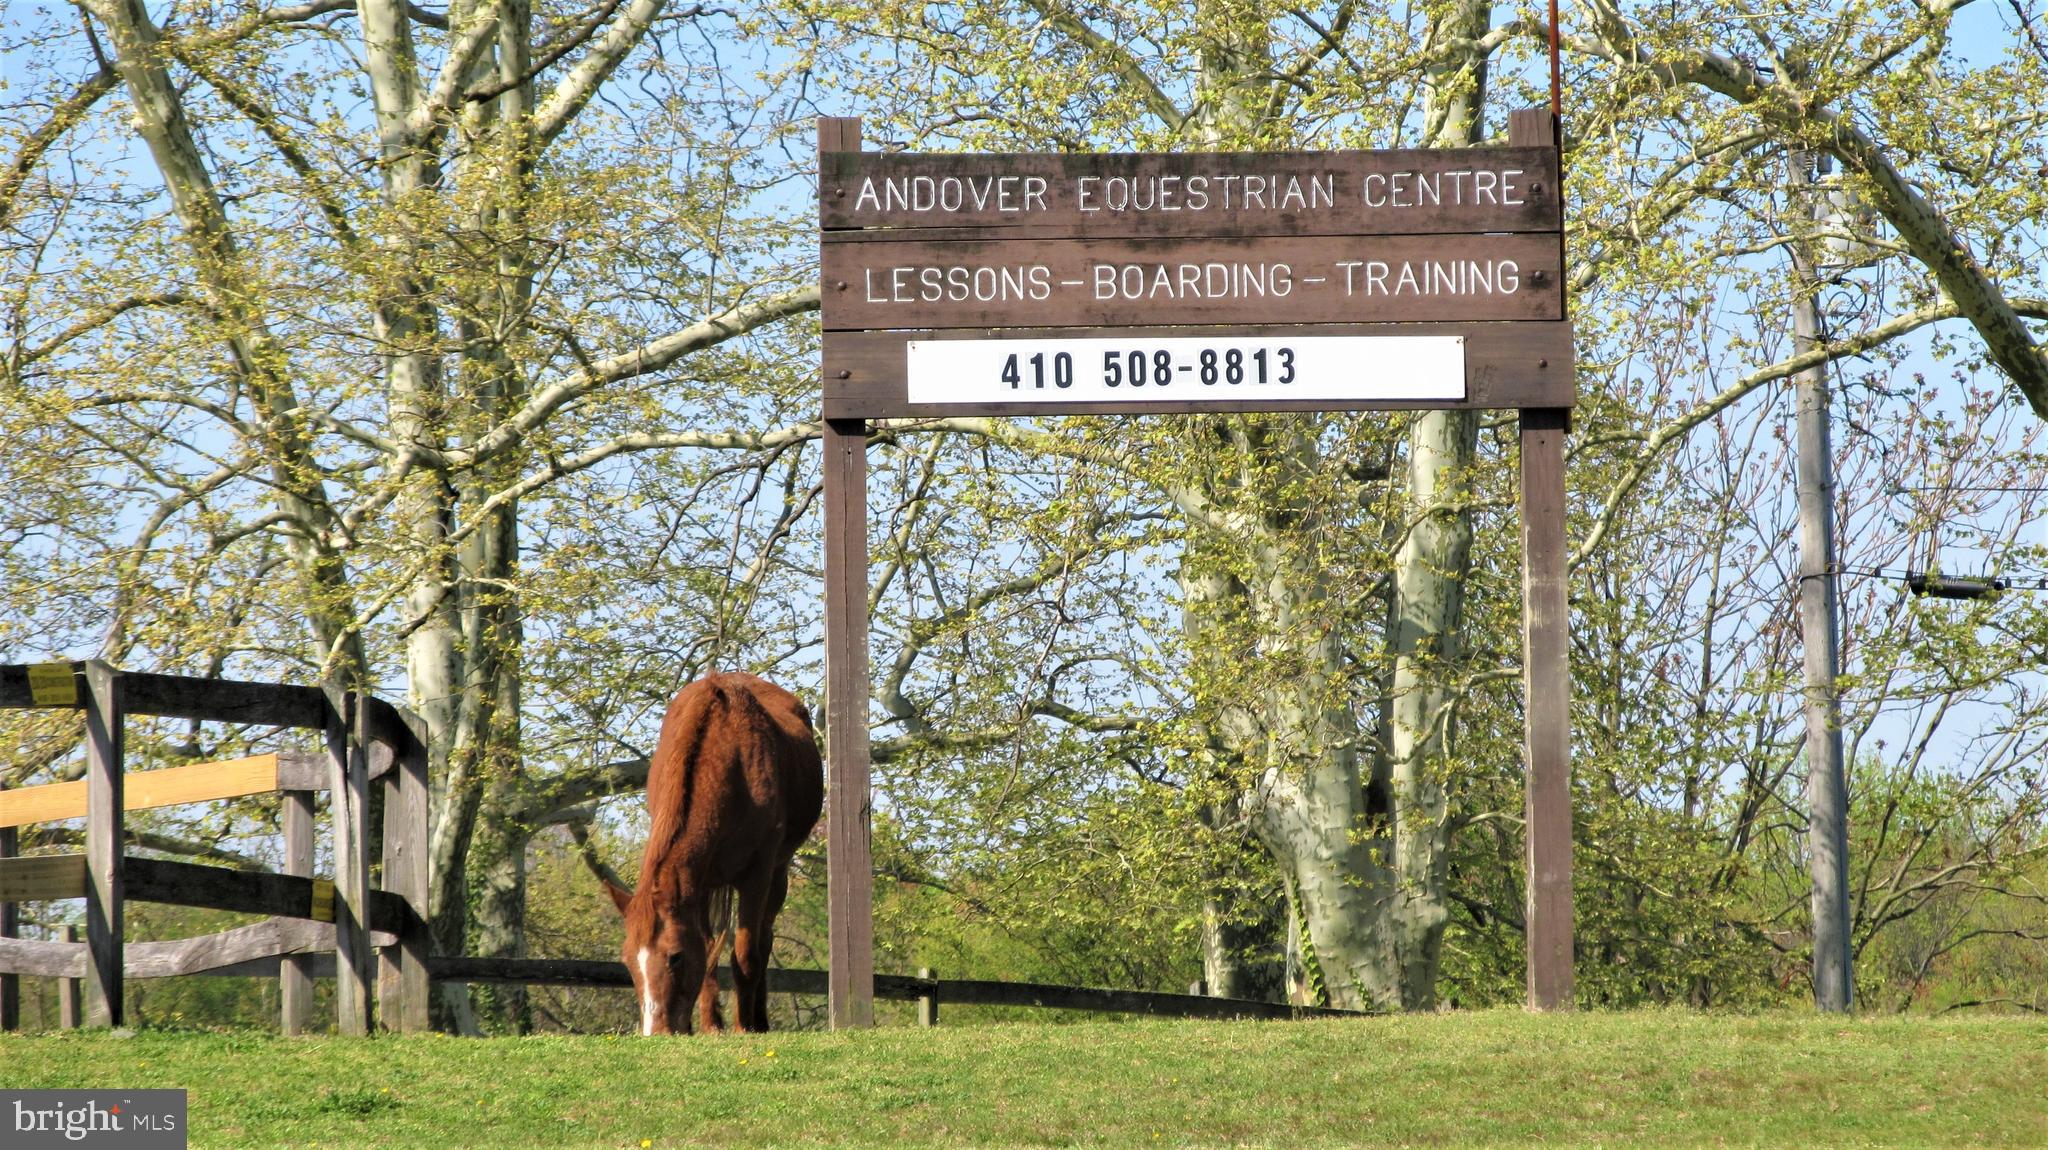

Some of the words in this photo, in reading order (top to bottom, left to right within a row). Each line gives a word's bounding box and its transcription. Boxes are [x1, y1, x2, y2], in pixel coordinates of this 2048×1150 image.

[855, 175, 1048, 212] ANDOVER
[1078, 174, 1334, 212] EQUESTRIAN
[1363, 170, 1525, 207] CENTRE
[865, 266, 1050, 302] LESSONS
[1094, 263, 1292, 299] BOARDING
[1336, 260, 1519, 296] TRAINING
[1001, 351, 1074, 389] 410
[1104, 348, 1295, 387] 508-8813
